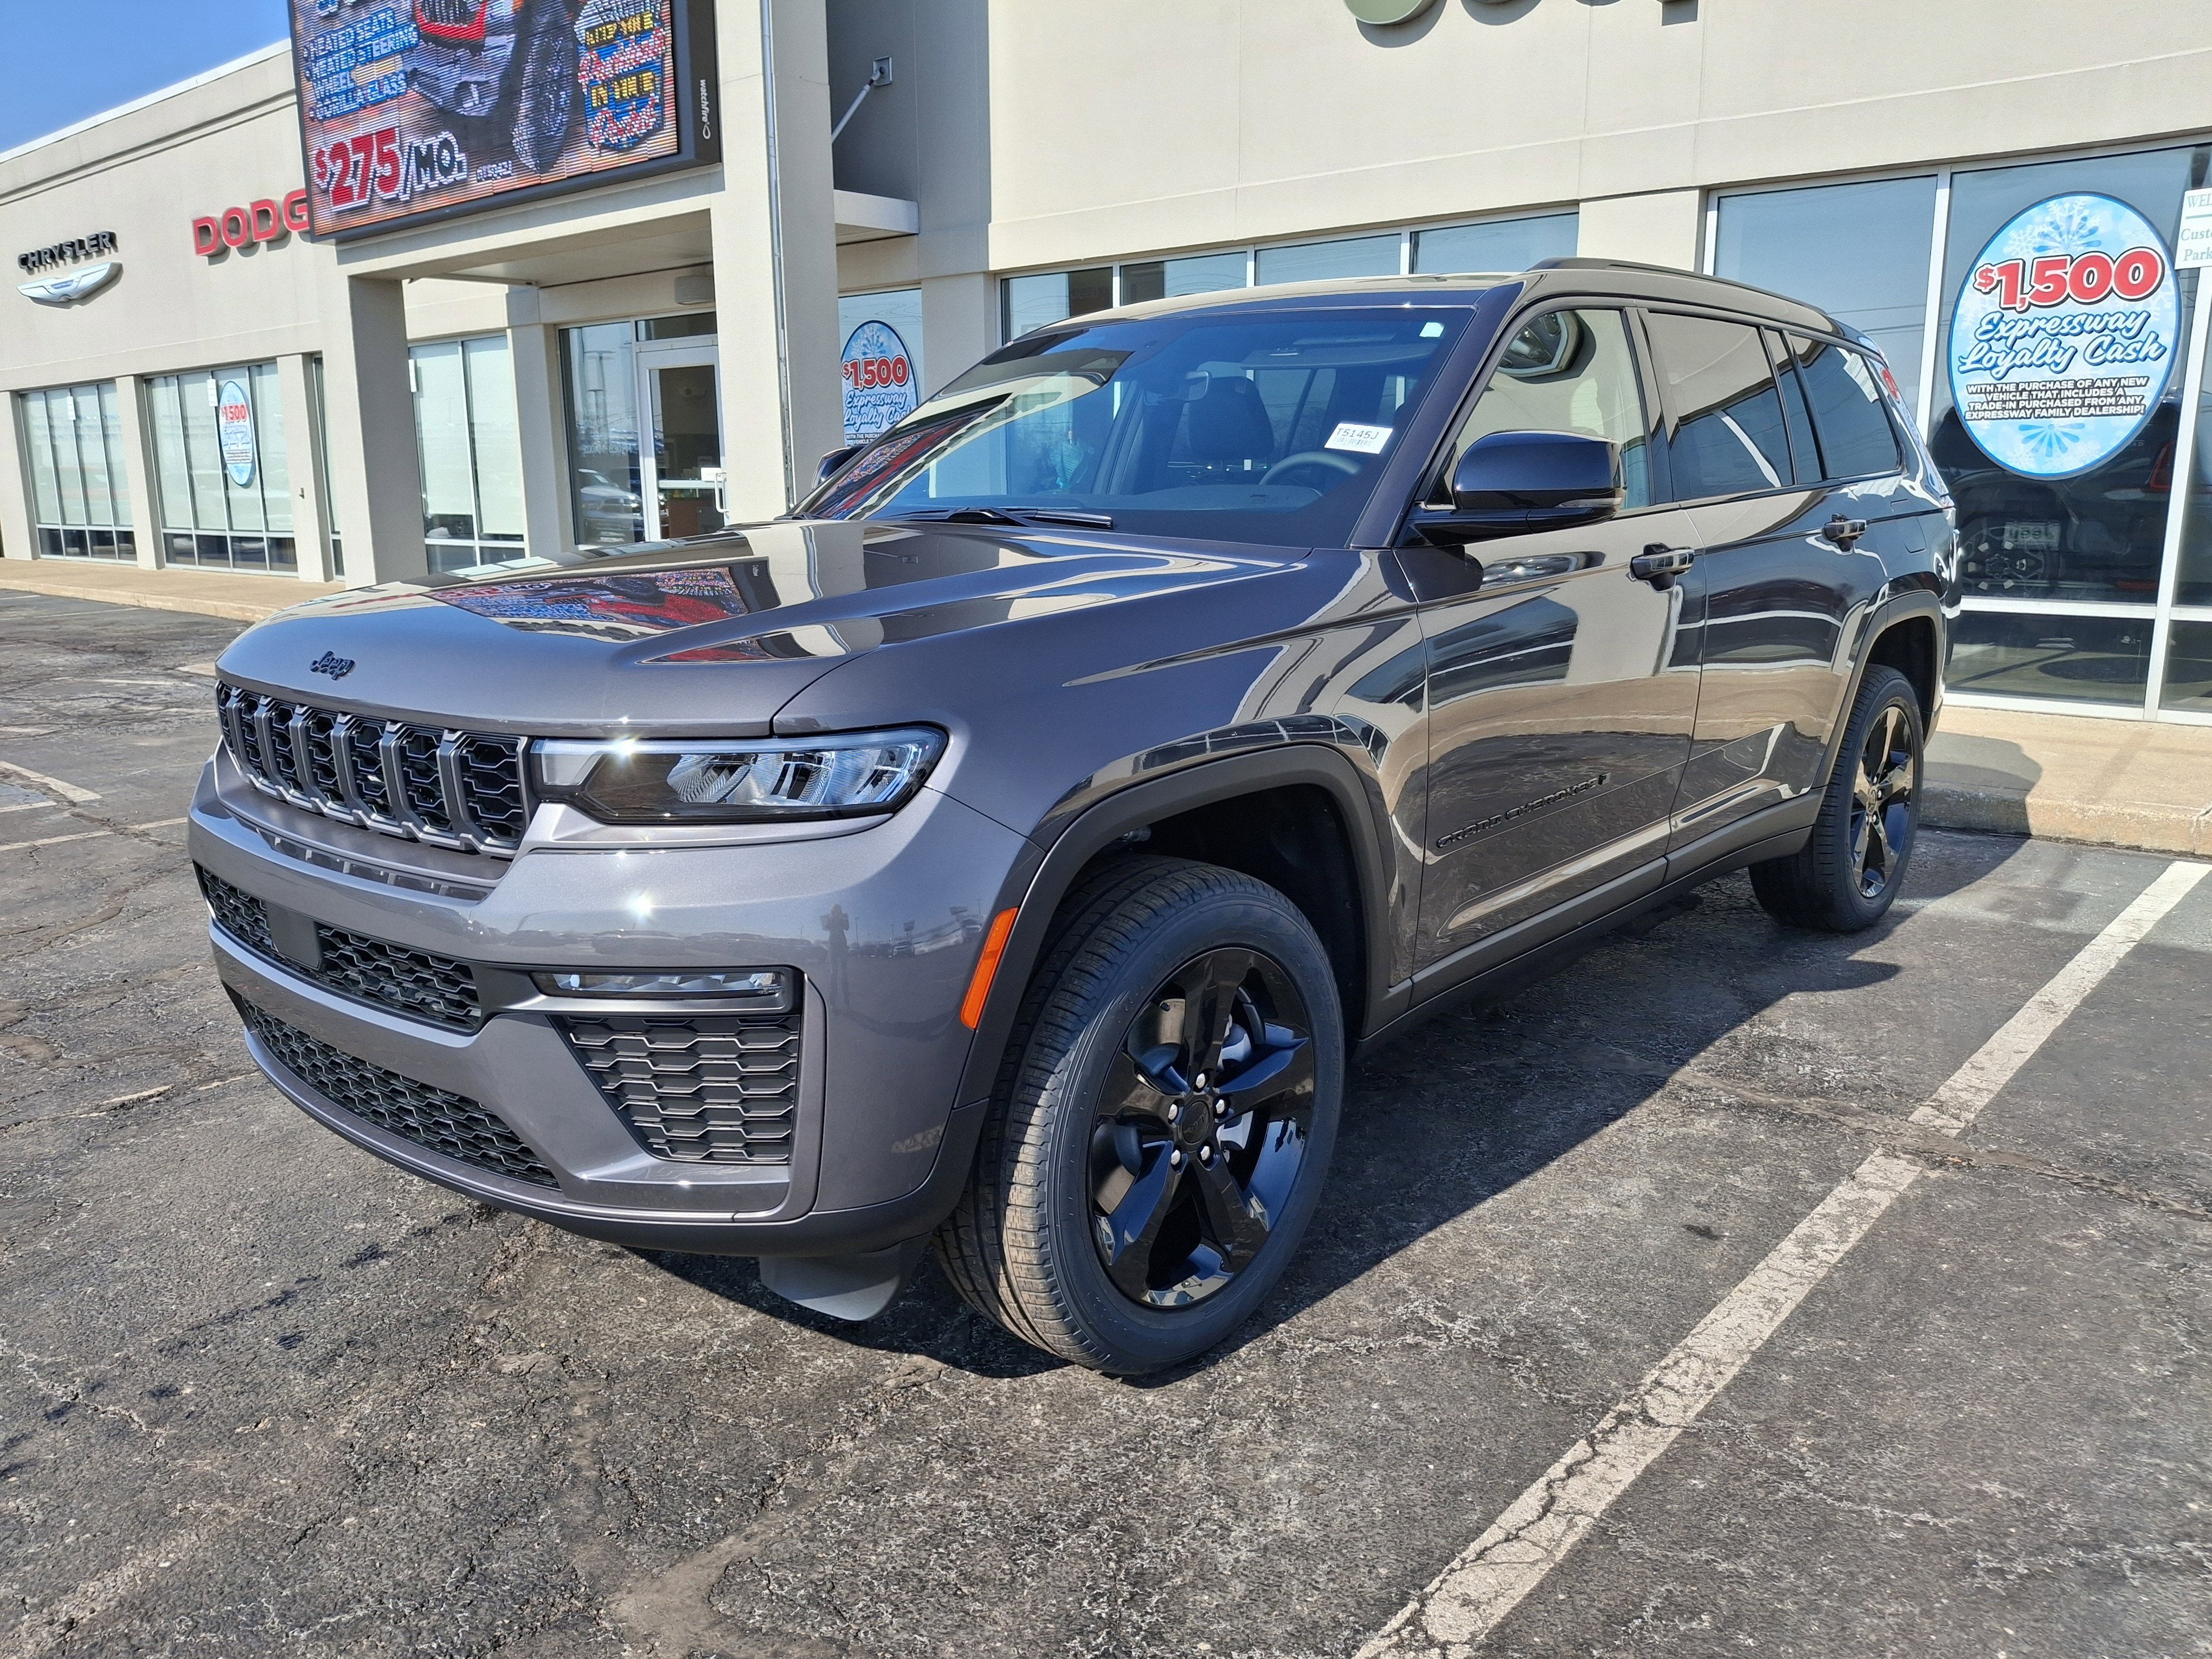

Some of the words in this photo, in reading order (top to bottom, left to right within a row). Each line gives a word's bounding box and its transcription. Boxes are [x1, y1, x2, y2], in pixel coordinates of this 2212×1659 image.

[700, 79, 710, 122] watchfire
[2181, 228, 2212, 241] Cust
[17, 232, 111, 270] CHRYSLER
[1975, 248, 2161, 311] $1,500
[1975, 311, 2150, 349] Expressway
[1958, 337, 2077, 380] Loyalty
[2083, 331, 2166, 366] Cash
[841, 356, 909, 391] $1,500
[1967, 384, 1994, 393] WITH
[1996, 383, 2016, 391] THE
[2019, 381, 2074, 391] PURCHASE
[2076, 380, 2092, 388] OF
[2094, 378, 2118, 387] ANY
[2120, 377, 2146, 386] NEW
[845, 390, 907, 413] Expressway
[1969, 401, 2017, 410] TRADE-IN
[2019, 398, 2082, 409] PURCHASED
[2085, 397, 2115, 406] FROM
[2118, 396, 2143, 404] ANY
[1986, 391, 2029, 401] VEHICLE
[2031, 389, 2058, 399] THAT
[2061, 388, 2113, 398] INCLUDES
[2116, 387, 2124, 395] A
[844, 406, 884, 432] Loyalty
[1965, 409, 2033, 419] EXPRESSWAY
[2035, 407, 2071, 417] FAMILY
[2074, 405, 2144, 416] DEALERSHIP!
[1337, 428, 1379, 440] T5145J
[310, 651, 355, 680] Jeep
[1438, 814, 1502, 848] GRAND
[1506, 777, 1598, 820] CHEROKEE
